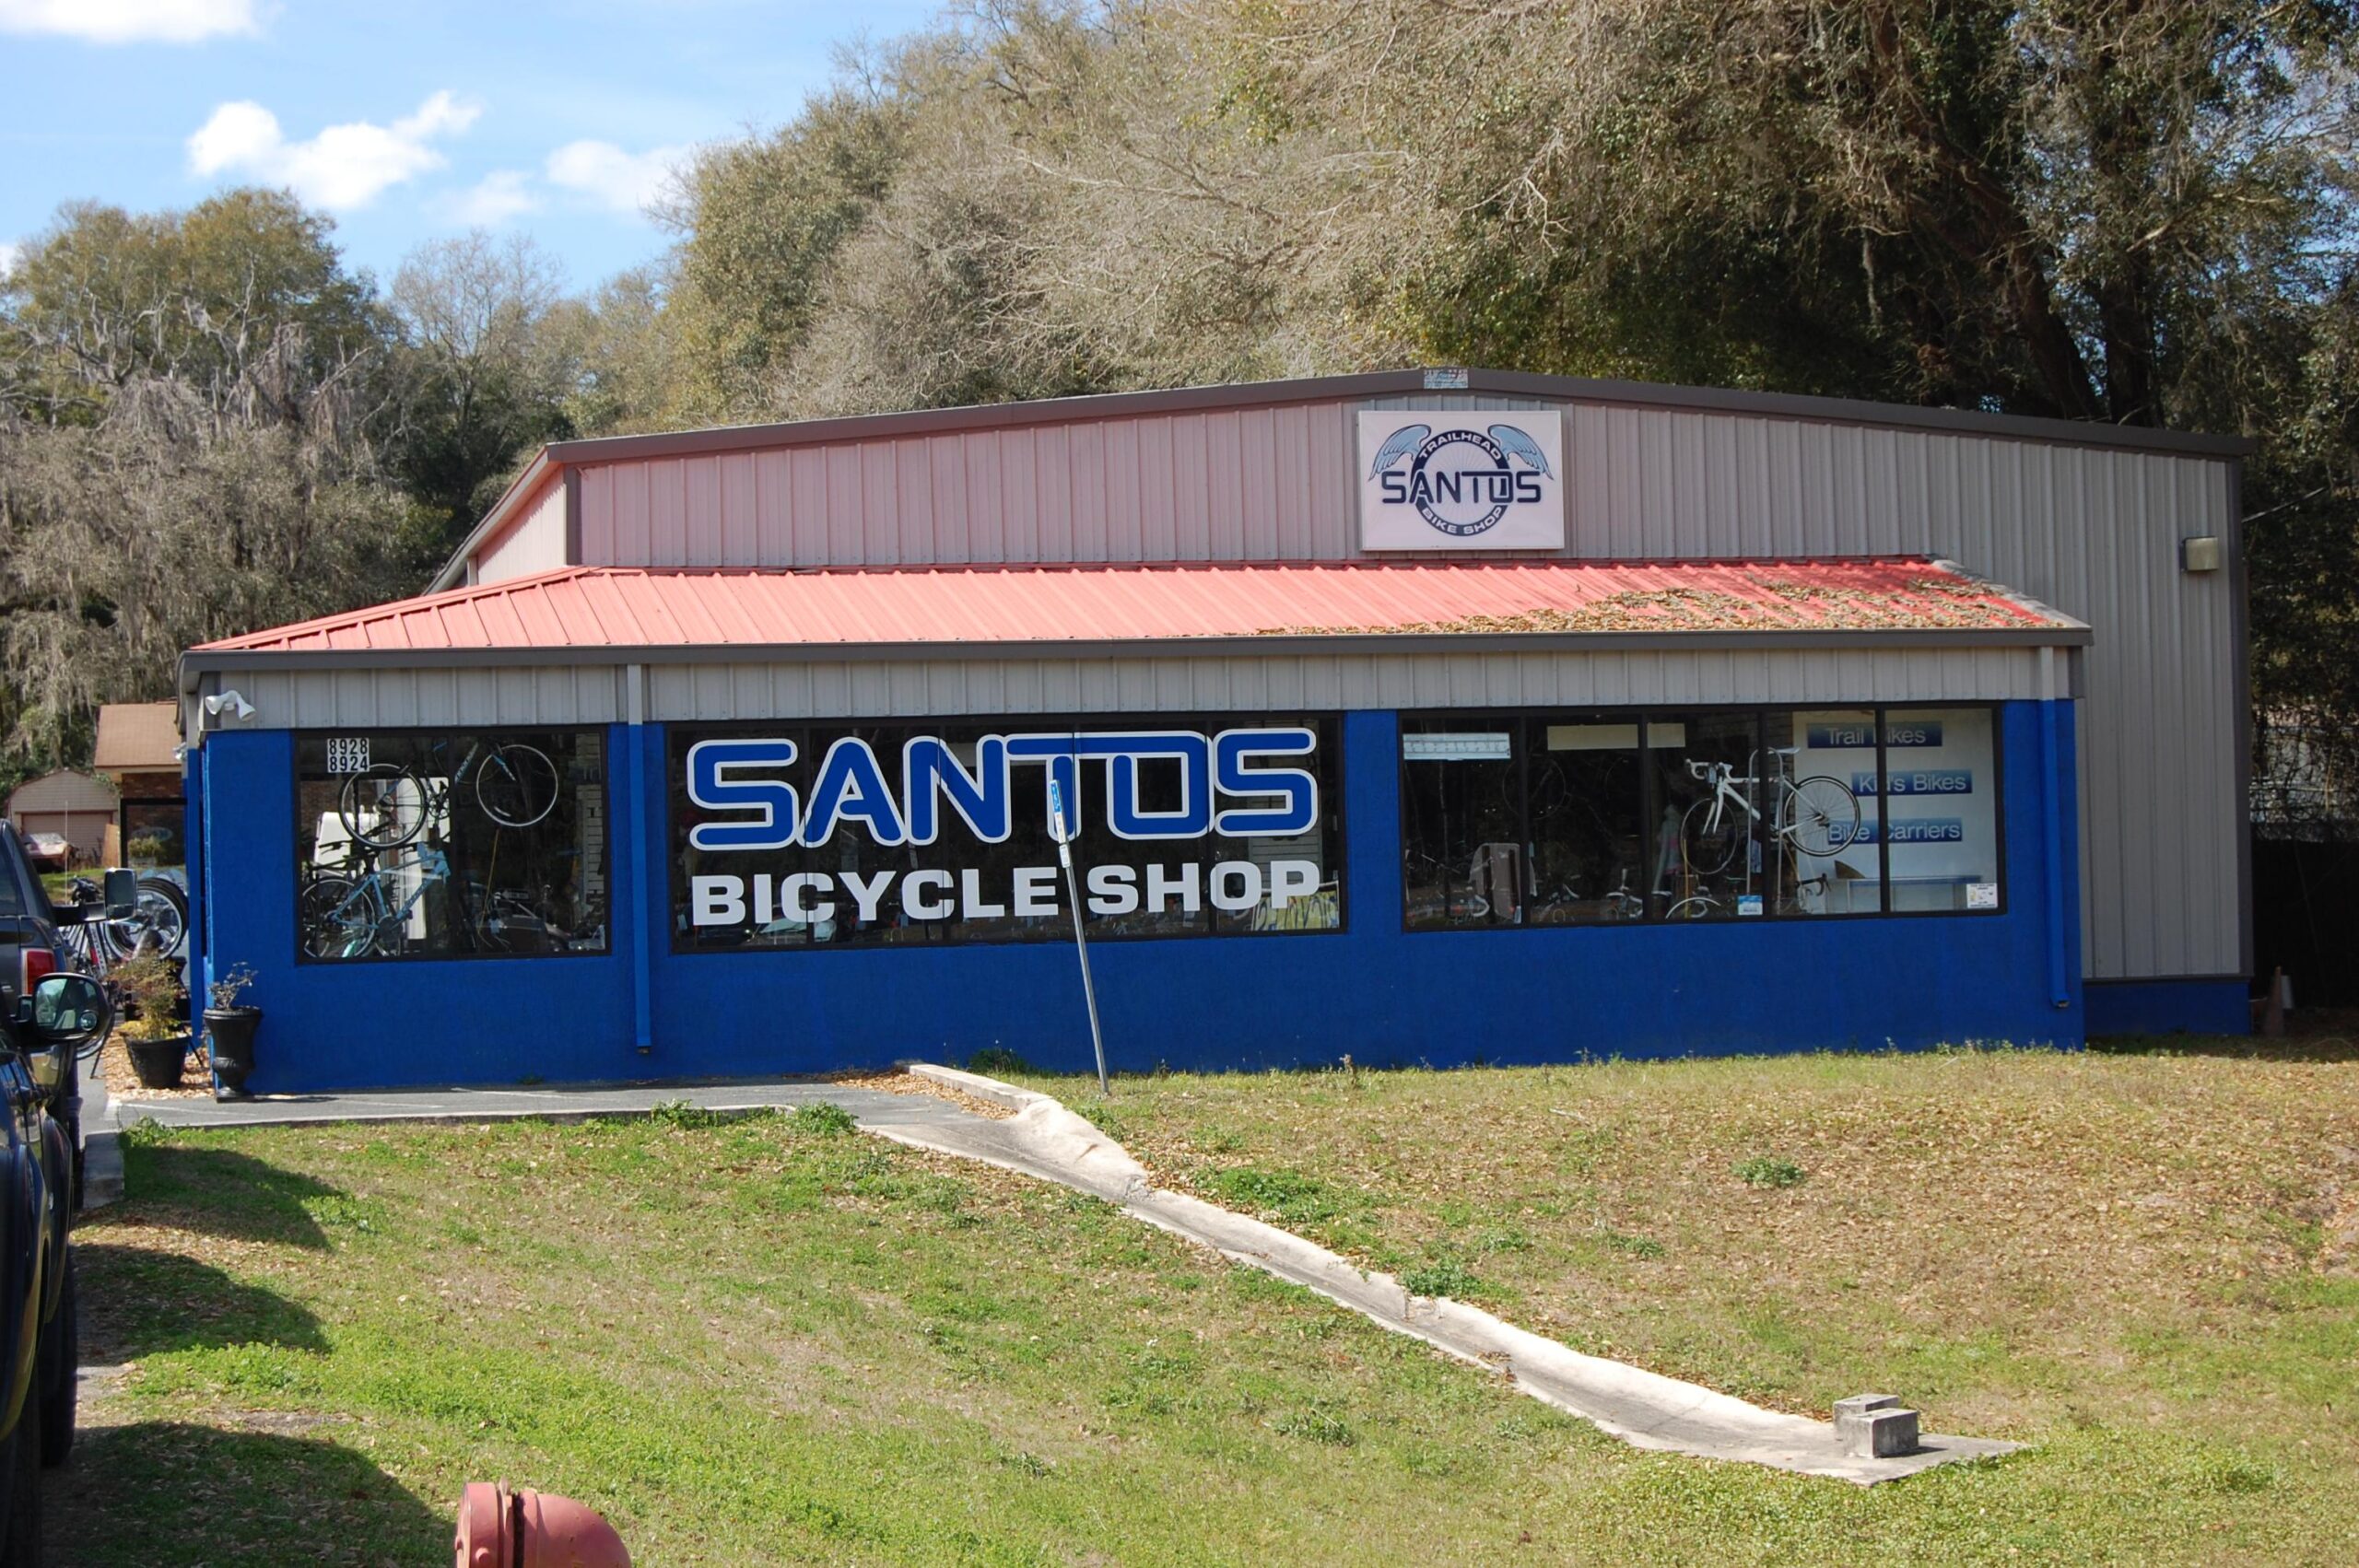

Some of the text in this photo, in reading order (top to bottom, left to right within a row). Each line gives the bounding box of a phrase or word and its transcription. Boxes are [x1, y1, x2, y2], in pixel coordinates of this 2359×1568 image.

[1419, 432, 1502, 461] TRAILHEAD
[1381, 471, 1542, 504] SANTOS
[1422, 506, 1502, 534] BIKE SHOP
[329, 738, 368, 755] 8928
[1826, 725, 1927, 744] Trail ikes
[329, 755, 368, 772] 8924
[687, 727, 1317, 850] SANTOS
[1913, 773, 1967, 792] Bikes
[691, 865, 1060, 926] BICYCLE
[1086, 860, 1320, 914] SHOP
